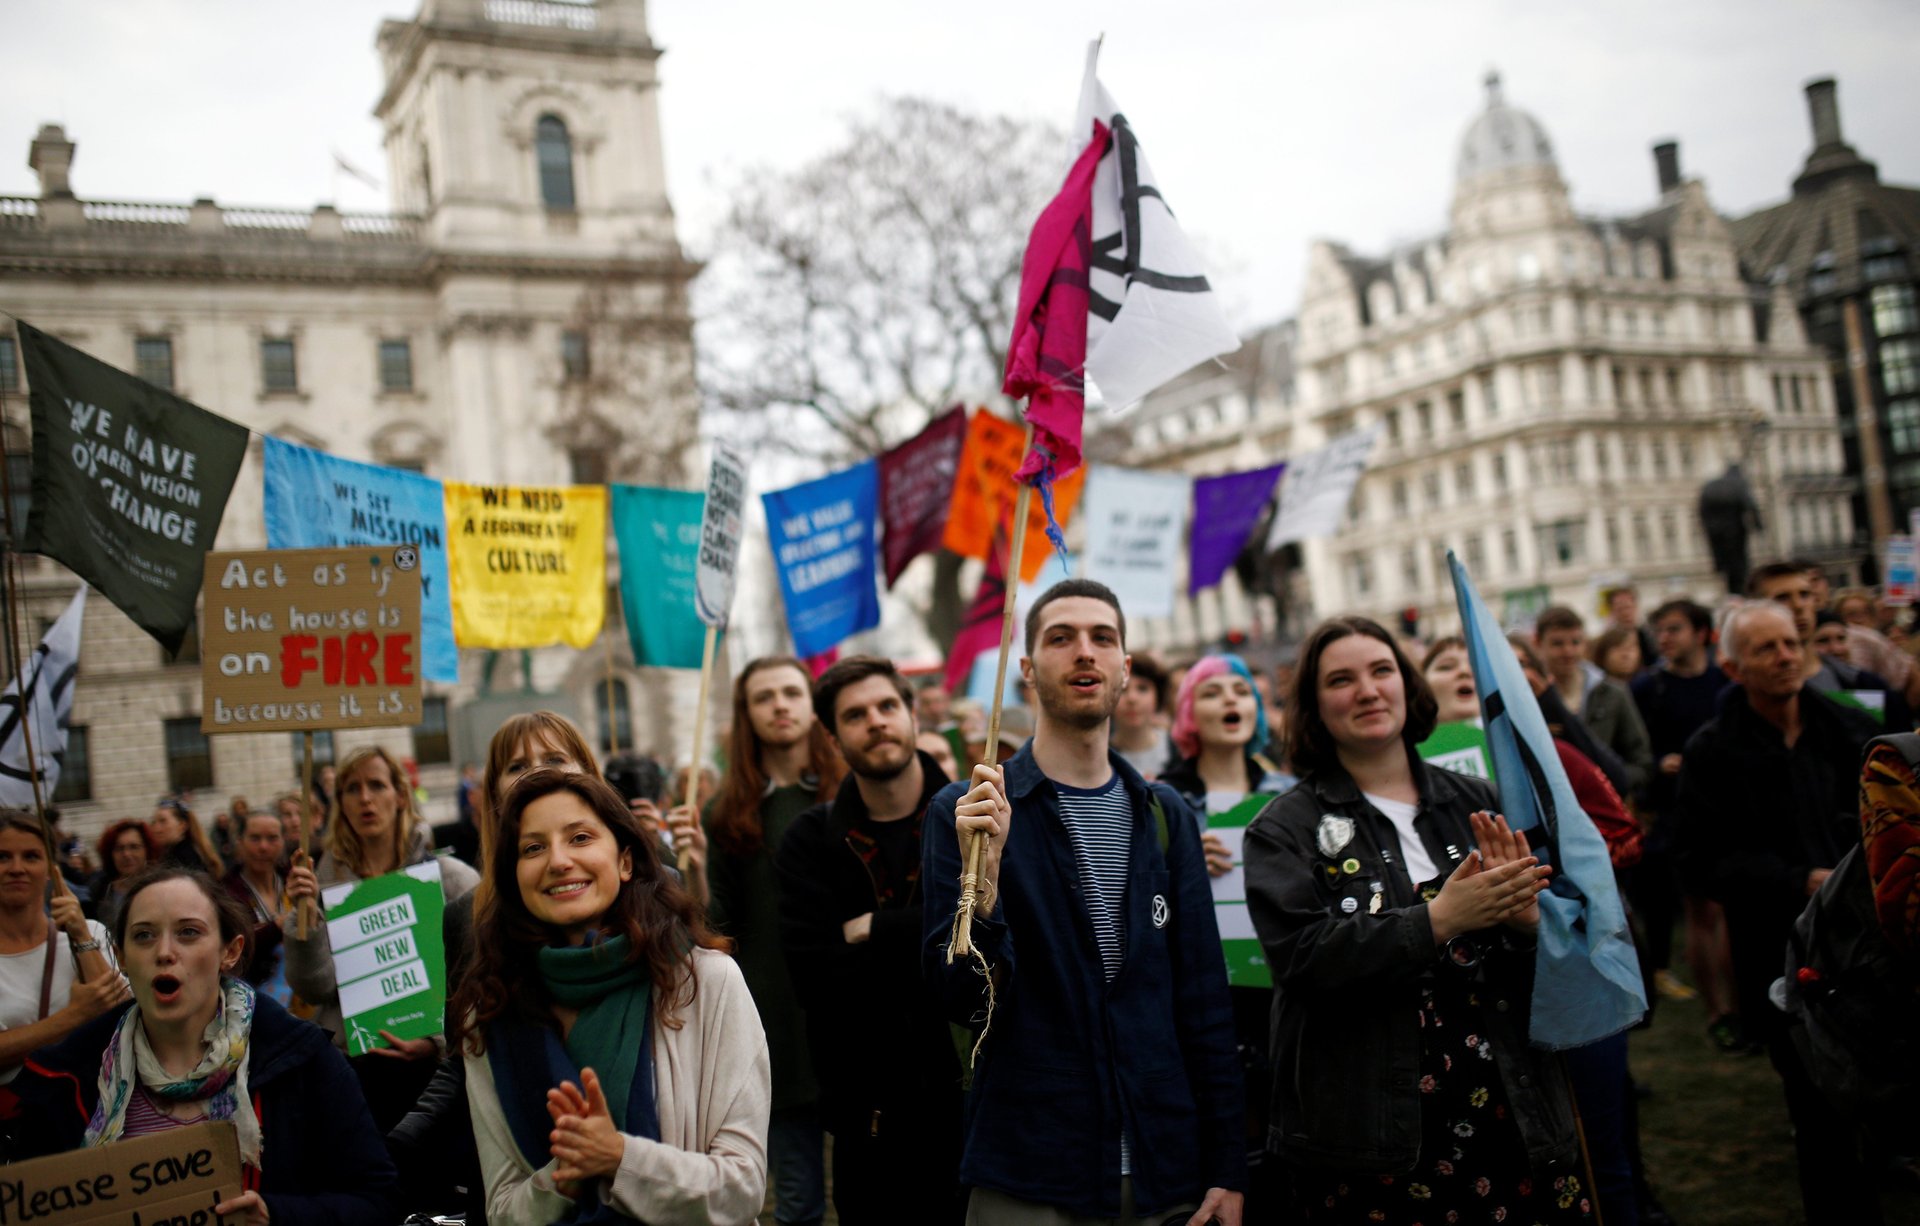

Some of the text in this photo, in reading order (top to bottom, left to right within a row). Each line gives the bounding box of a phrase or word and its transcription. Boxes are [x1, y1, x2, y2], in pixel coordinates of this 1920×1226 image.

[64, 397, 197, 480] WE HAVE
[140, 469, 201, 509] VISION
[333, 482, 391, 514] WE SET
[482, 487, 509, 509] WE
[352, 508, 441, 549] MISSION
[463, 517, 476, 535] A
[221, 558, 288, 590] Act
[313, 562, 348, 587] as
[369, 554, 394, 598] if
[486, 547, 567, 575] CULTURE
[223, 602, 402, 634] the house is
[219, 629, 415, 689] on FIRE
[213, 696, 323, 725] because
[339, 693, 363, 719] it
[358, 902, 411, 936] GREEN
[373, 936, 411, 966] NEW
[380, 968, 423, 998] DEAL
[0, 1149, 215, 1225] Please save
